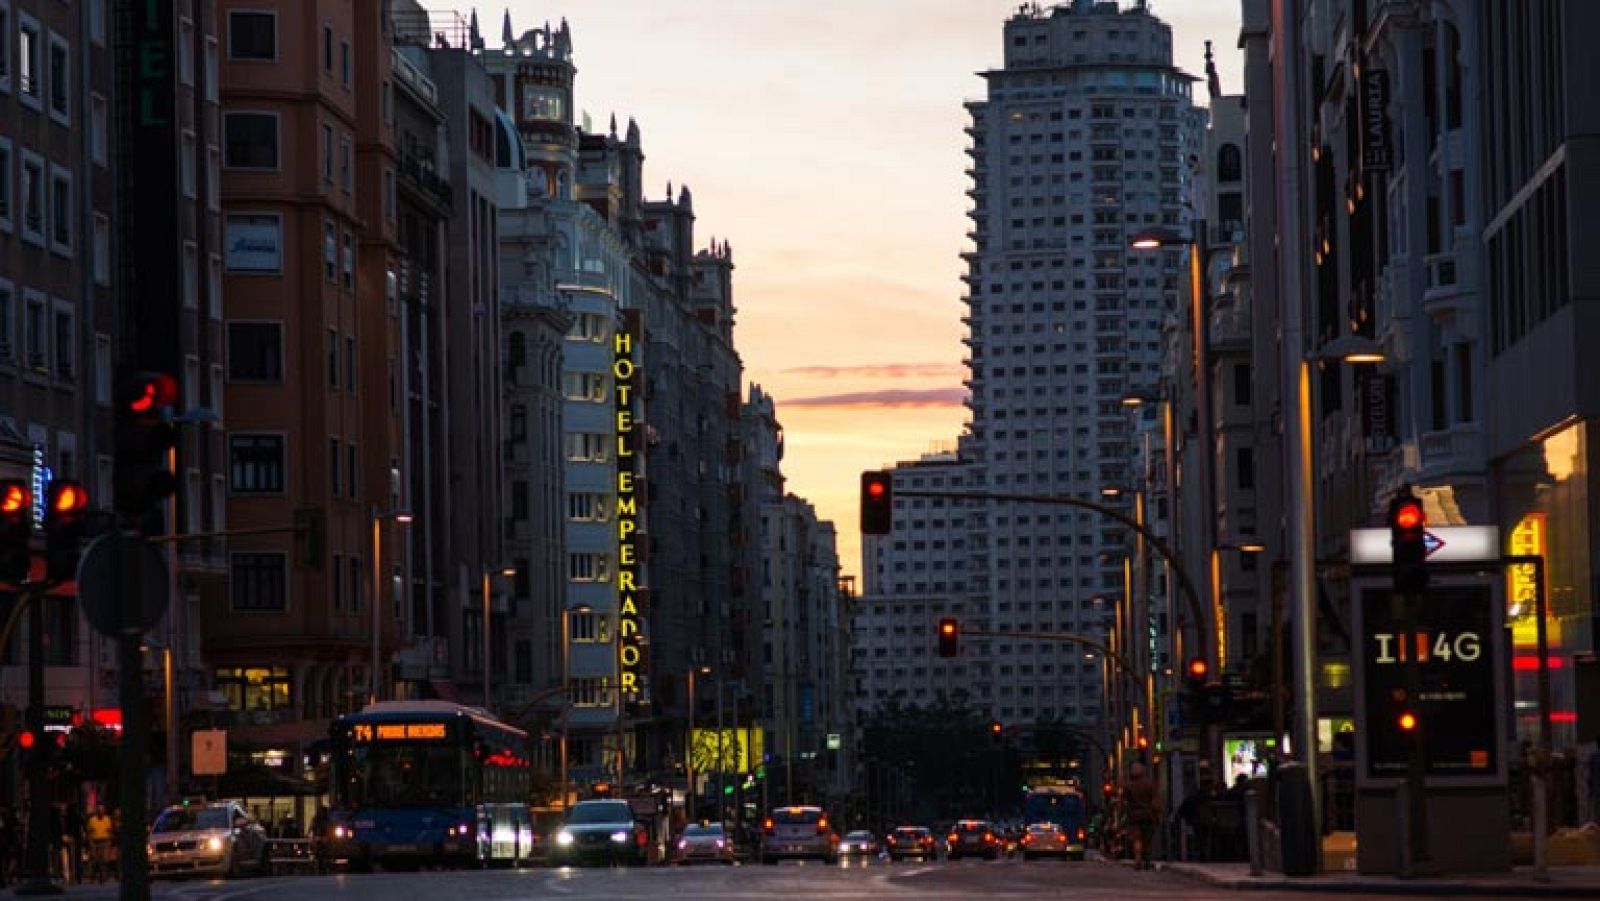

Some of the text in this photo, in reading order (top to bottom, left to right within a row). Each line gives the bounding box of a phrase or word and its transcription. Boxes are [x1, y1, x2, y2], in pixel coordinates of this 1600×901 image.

[613, 332, 641, 694] HOTEL EMPERADOR
[1432, 632, 1481, 662] 4G
